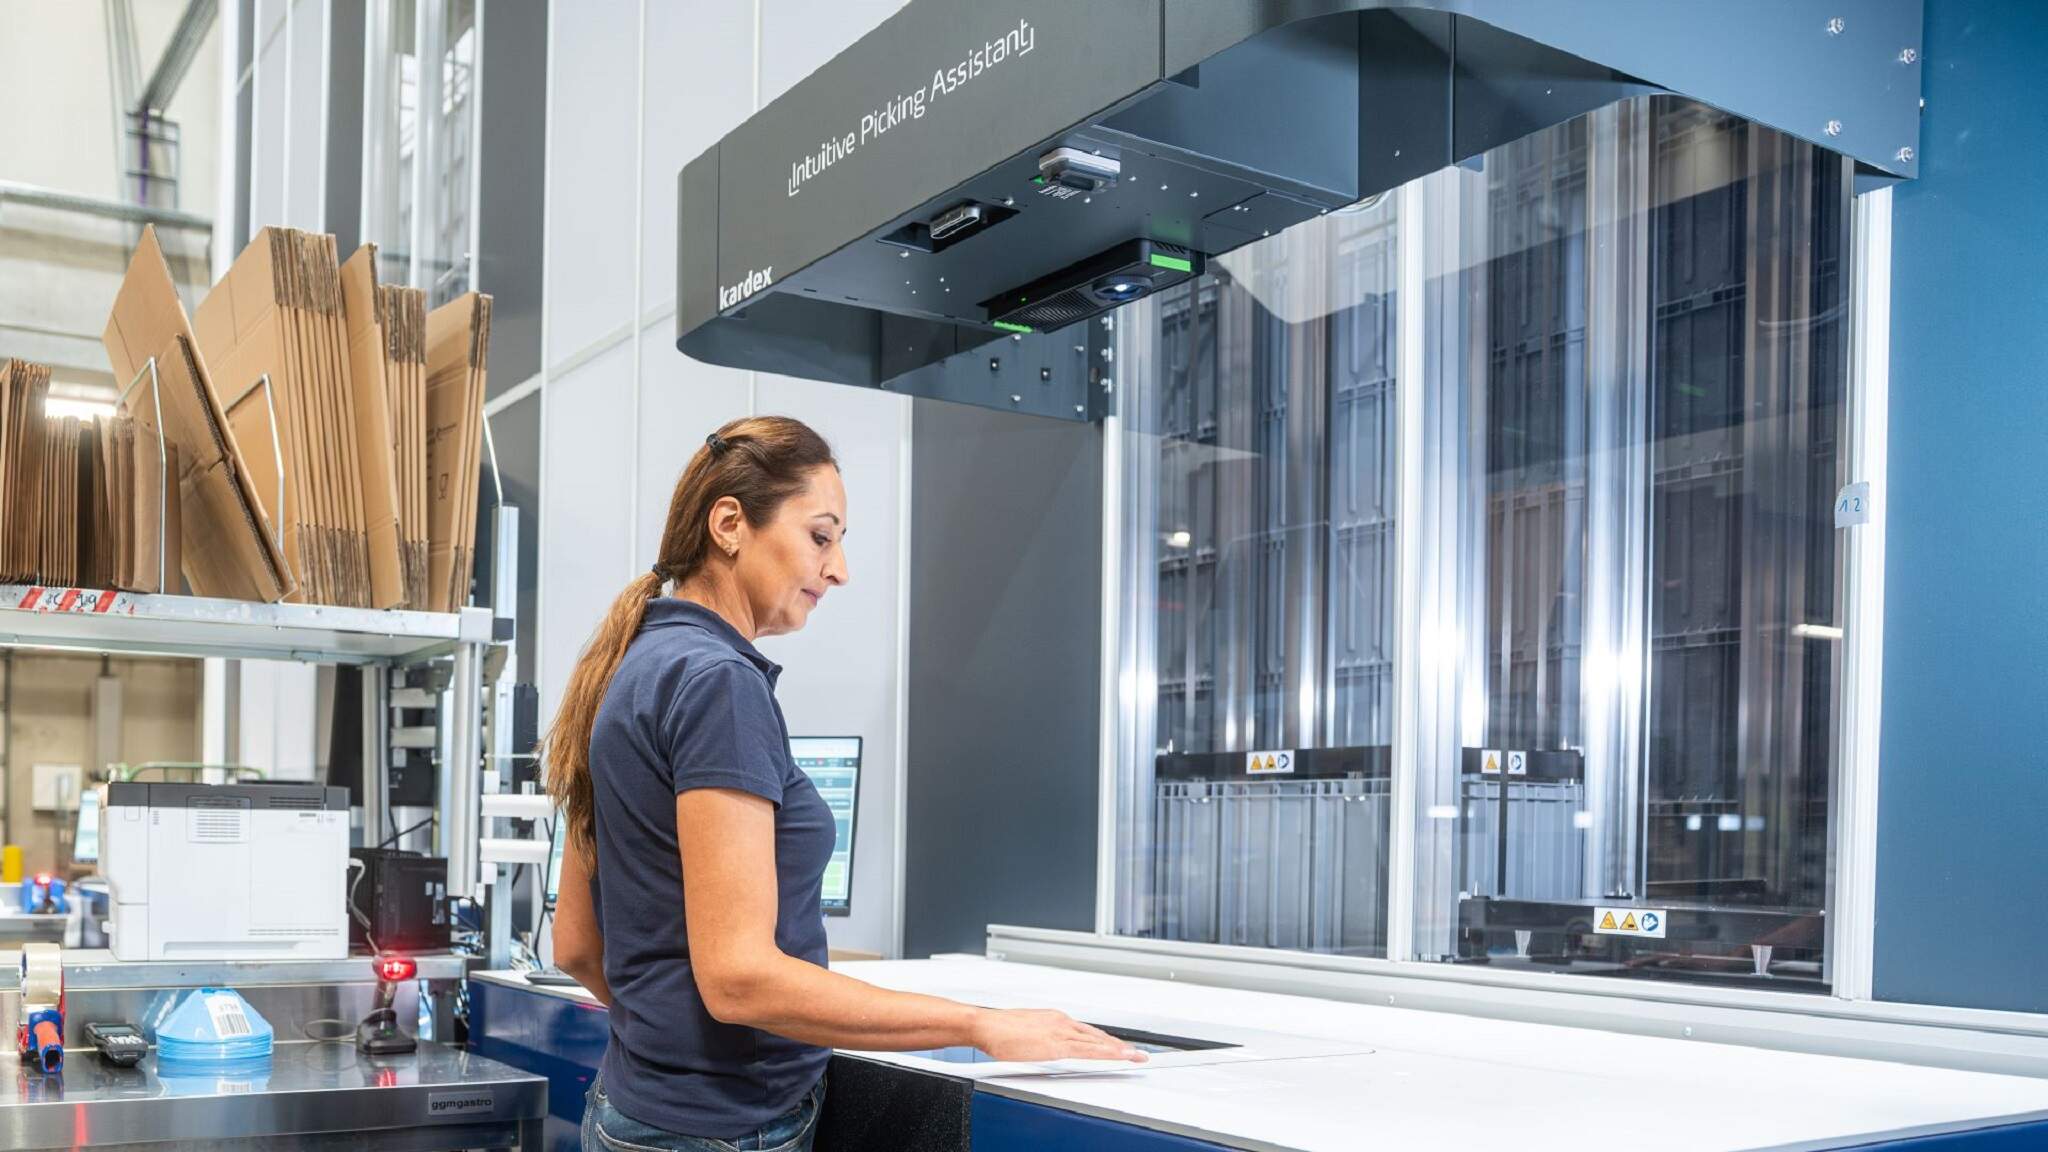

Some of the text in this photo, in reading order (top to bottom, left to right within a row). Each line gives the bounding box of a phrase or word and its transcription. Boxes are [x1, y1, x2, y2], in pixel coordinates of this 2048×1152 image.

[790, 18, 1032, 193] Intuitive Picking Assistant
[719, 265, 772, 311] kardex
[431, 1098, 492, 1111] ggmgastro
